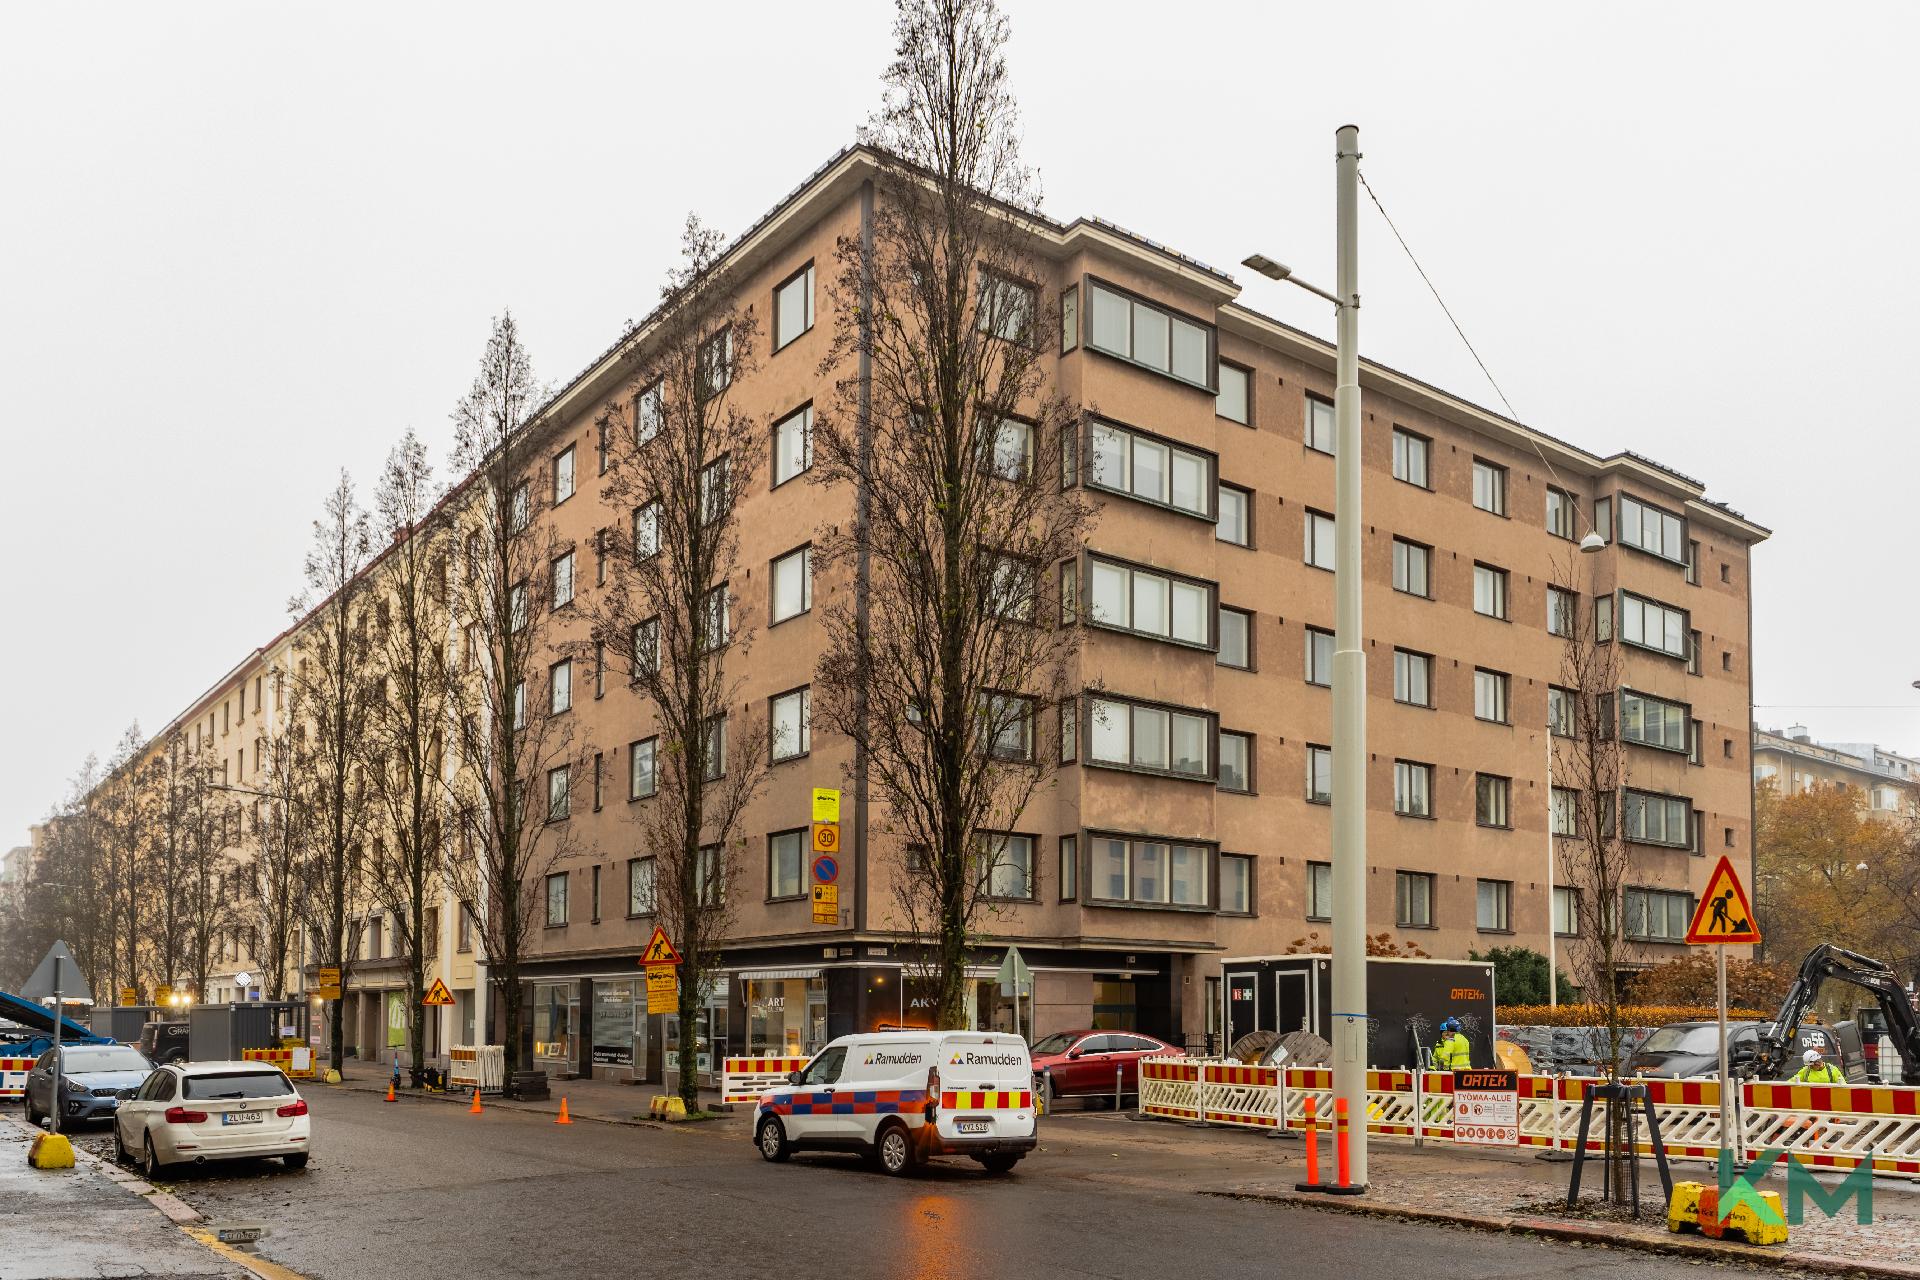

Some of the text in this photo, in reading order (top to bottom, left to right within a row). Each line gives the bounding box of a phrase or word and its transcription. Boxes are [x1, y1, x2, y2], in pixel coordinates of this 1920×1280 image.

[821, 833, 833, 843] 30
[768, 997, 785, 1007] ART
[168, 1026, 190, 1036] GRA
[875, 1052, 922, 1065] Ramudden
[966, 1052, 1022, 1066] Ramudden
[1457, 1092, 1512, 1103] TYÖMAA-ALUE
[229, 1112, 261, 1122] ZLU-463
